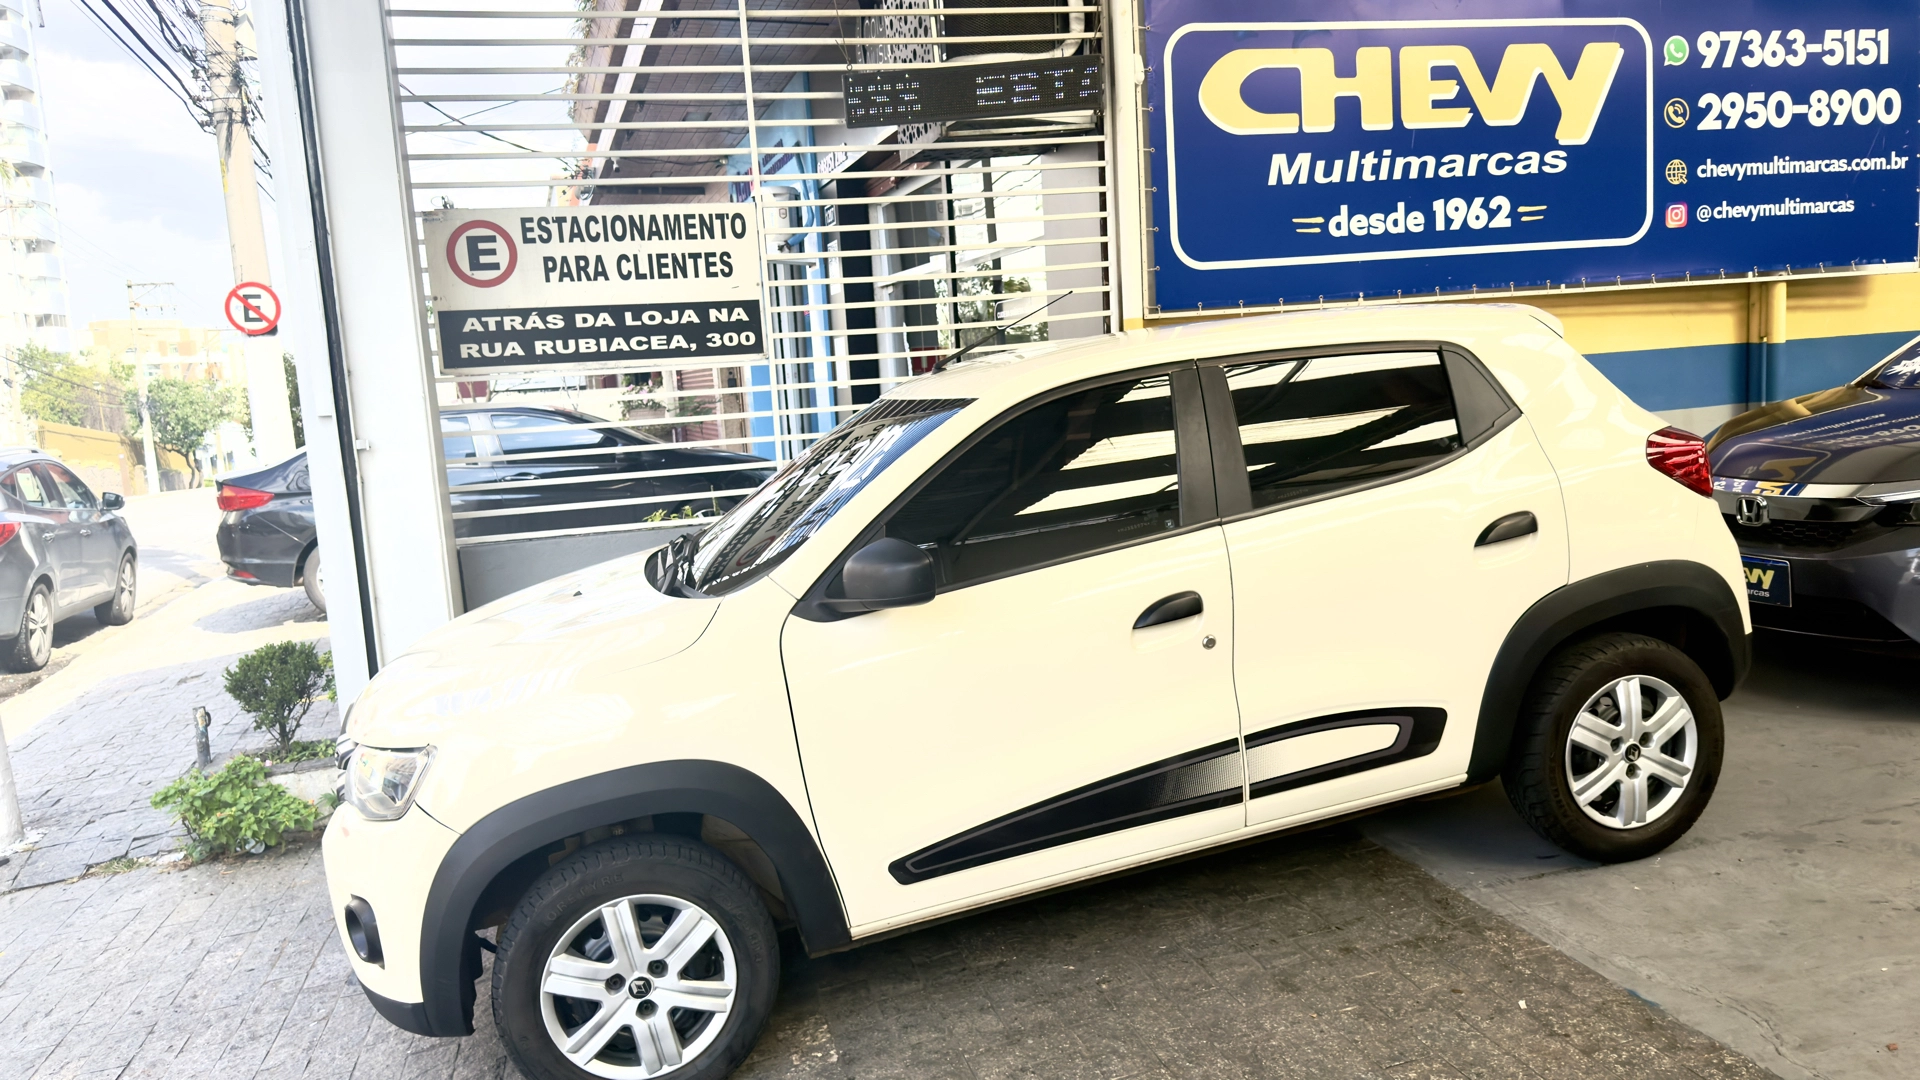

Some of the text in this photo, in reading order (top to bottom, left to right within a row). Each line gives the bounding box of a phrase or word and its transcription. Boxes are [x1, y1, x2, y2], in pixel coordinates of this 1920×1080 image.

[1697, 28, 1890, 69] 97363-5151
[1199, 42, 1625, 145] CHEVY
[1697, 88, 1902, 130] 2950-8900
[1267, 148, 1568, 186] Multimarcas
[1697, 151, 1909, 181] chevymultimarcas.com.br
[1328, 195, 1512, 238] desde 1962
[1697, 198, 1855, 222] @chevymultimarcas
[520, 212, 747, 244] ESTACIONAMENTO
[466, 235, 501, 272] E
[543, 251, 734, 283] PARA CLIENTES
[243, 294, 263, 322] E
[462, 307, 749, 332] ATRÁS DA LOJA NA
[460, 331, 756, 359] RUA RUBIACEA, 300
